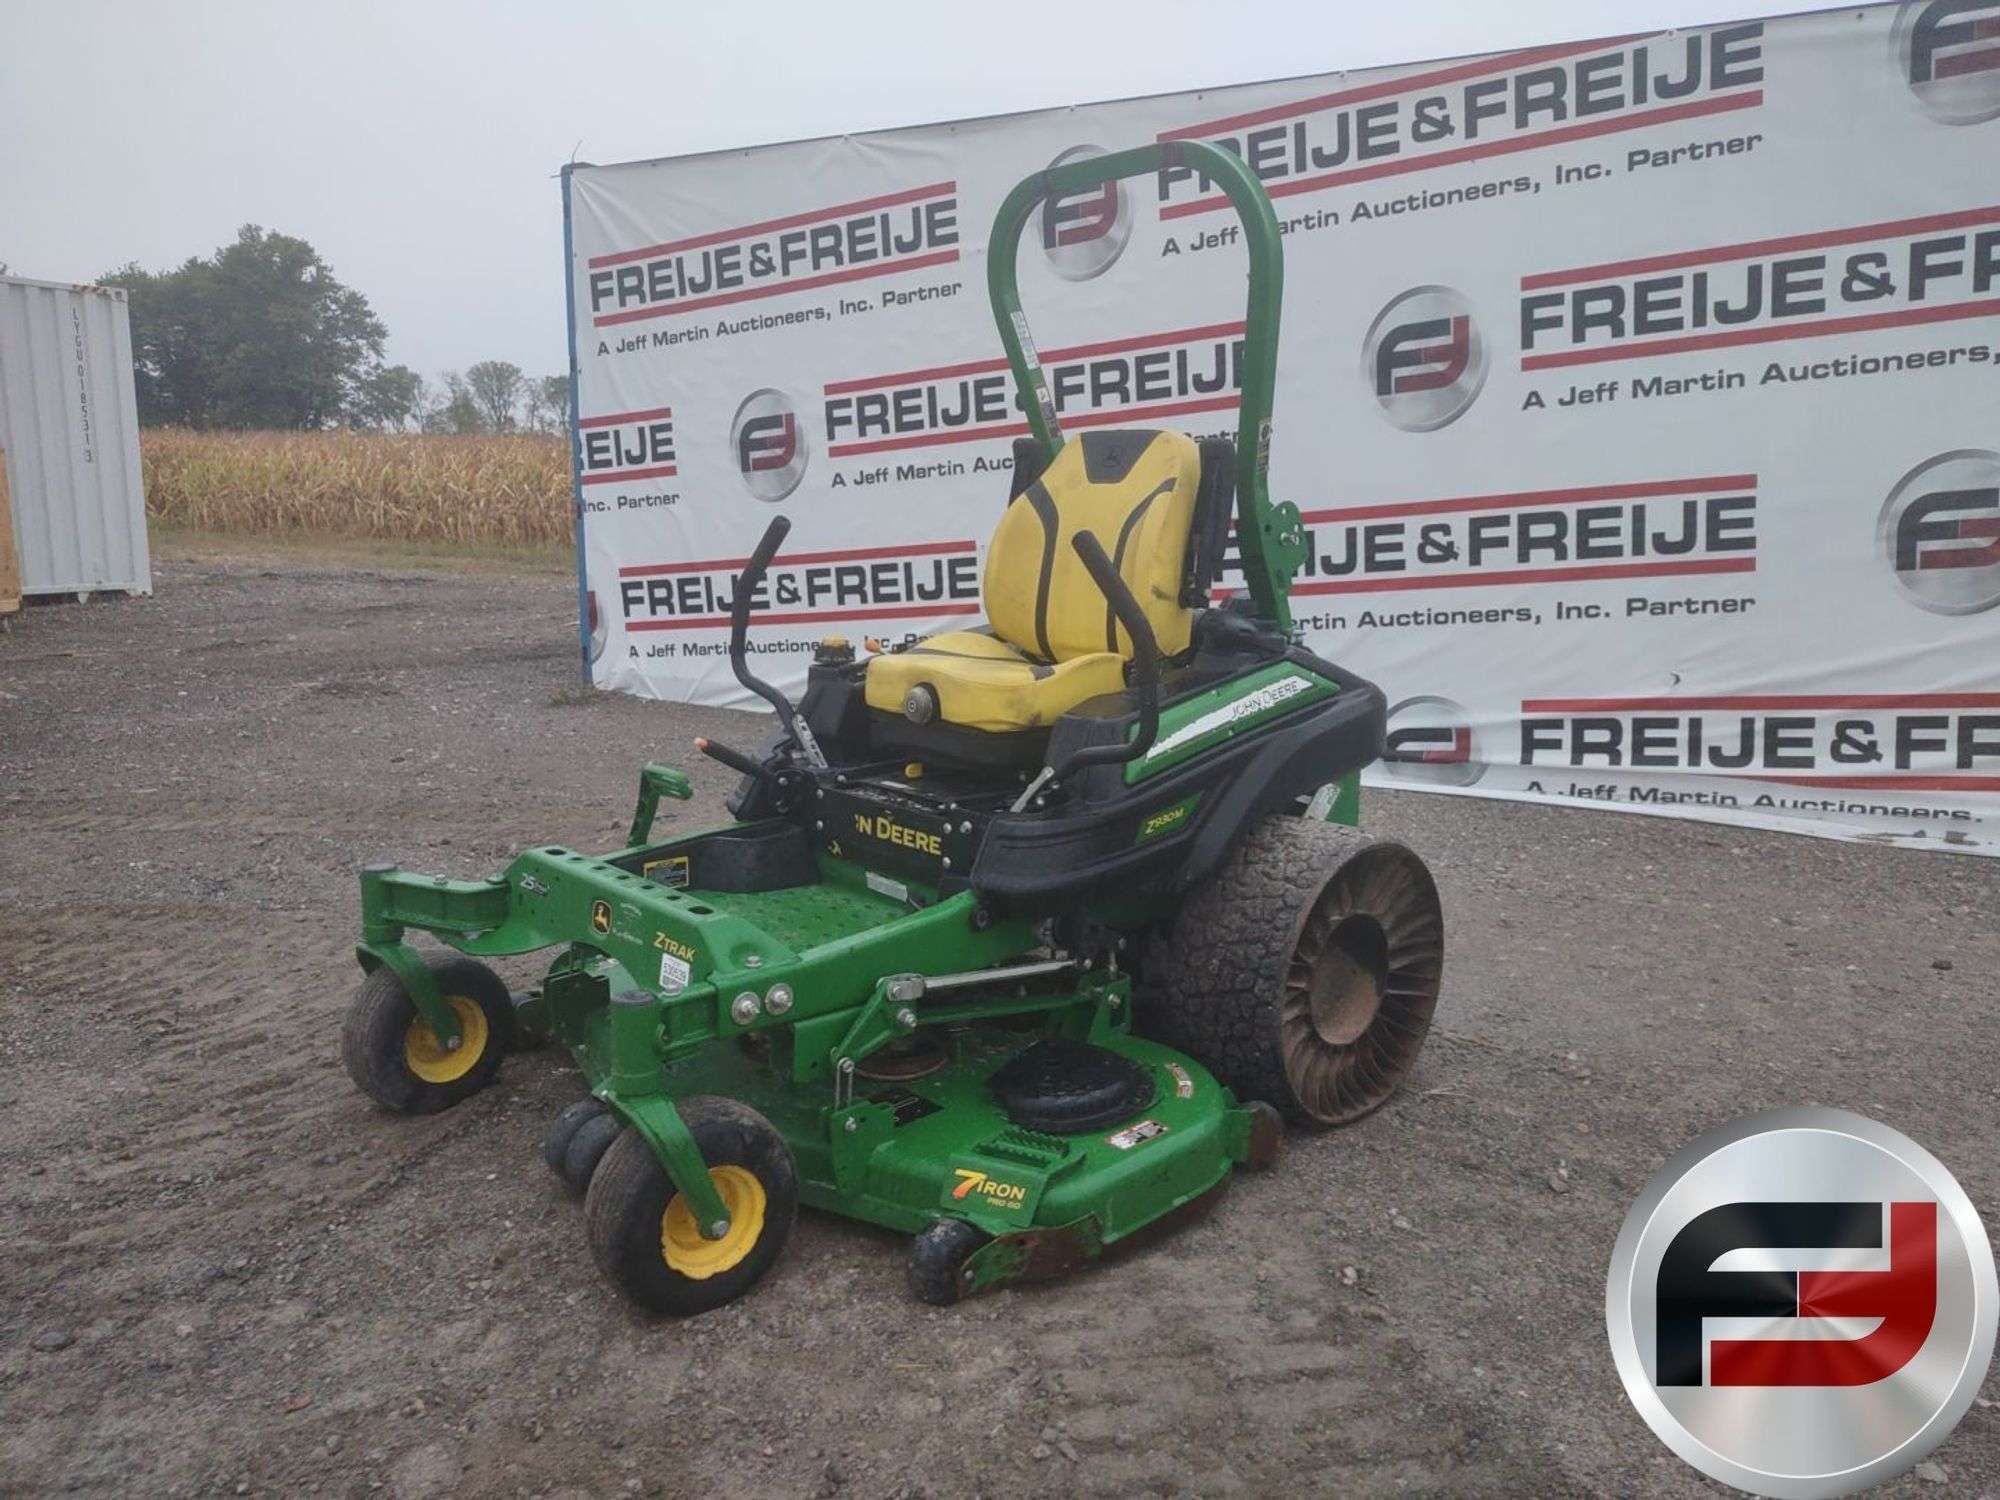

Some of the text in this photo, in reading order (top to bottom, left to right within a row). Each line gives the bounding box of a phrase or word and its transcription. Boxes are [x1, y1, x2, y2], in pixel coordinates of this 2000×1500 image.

[1162, 237, 1180, 257] A
[1190, 227, 1238, 251] Jeff
[1351, 174, 1541, 222] Auctioneers,
[1555, 163, 1612, 186] Inc.
[1627, 133, 1763, 172] Partner
[597, 281, 962, 357] A Jeff Martin Auctioneers, Inc. Partner
[1522, 391, 1545, 411] A
[1558, 380, 1618, 407] Jeff
[1631, 369, 1746, 401] Martin
[831, 472, 846, 488] A
[854, 467, 887, 486] Jeff
[897, 460, 964, 481] Martin
[617, 494, 680, 510] Partner
[1357, 604, 1542, 631] Auctioneers,
[1557, 600, 1609, 622] Inc.
[1626, 596, 1756, 618] Partner
[629, 645, 639, 658] A
[647, 643, 676, 658] Jeff
[877, 816, 942, 856] DEERE
